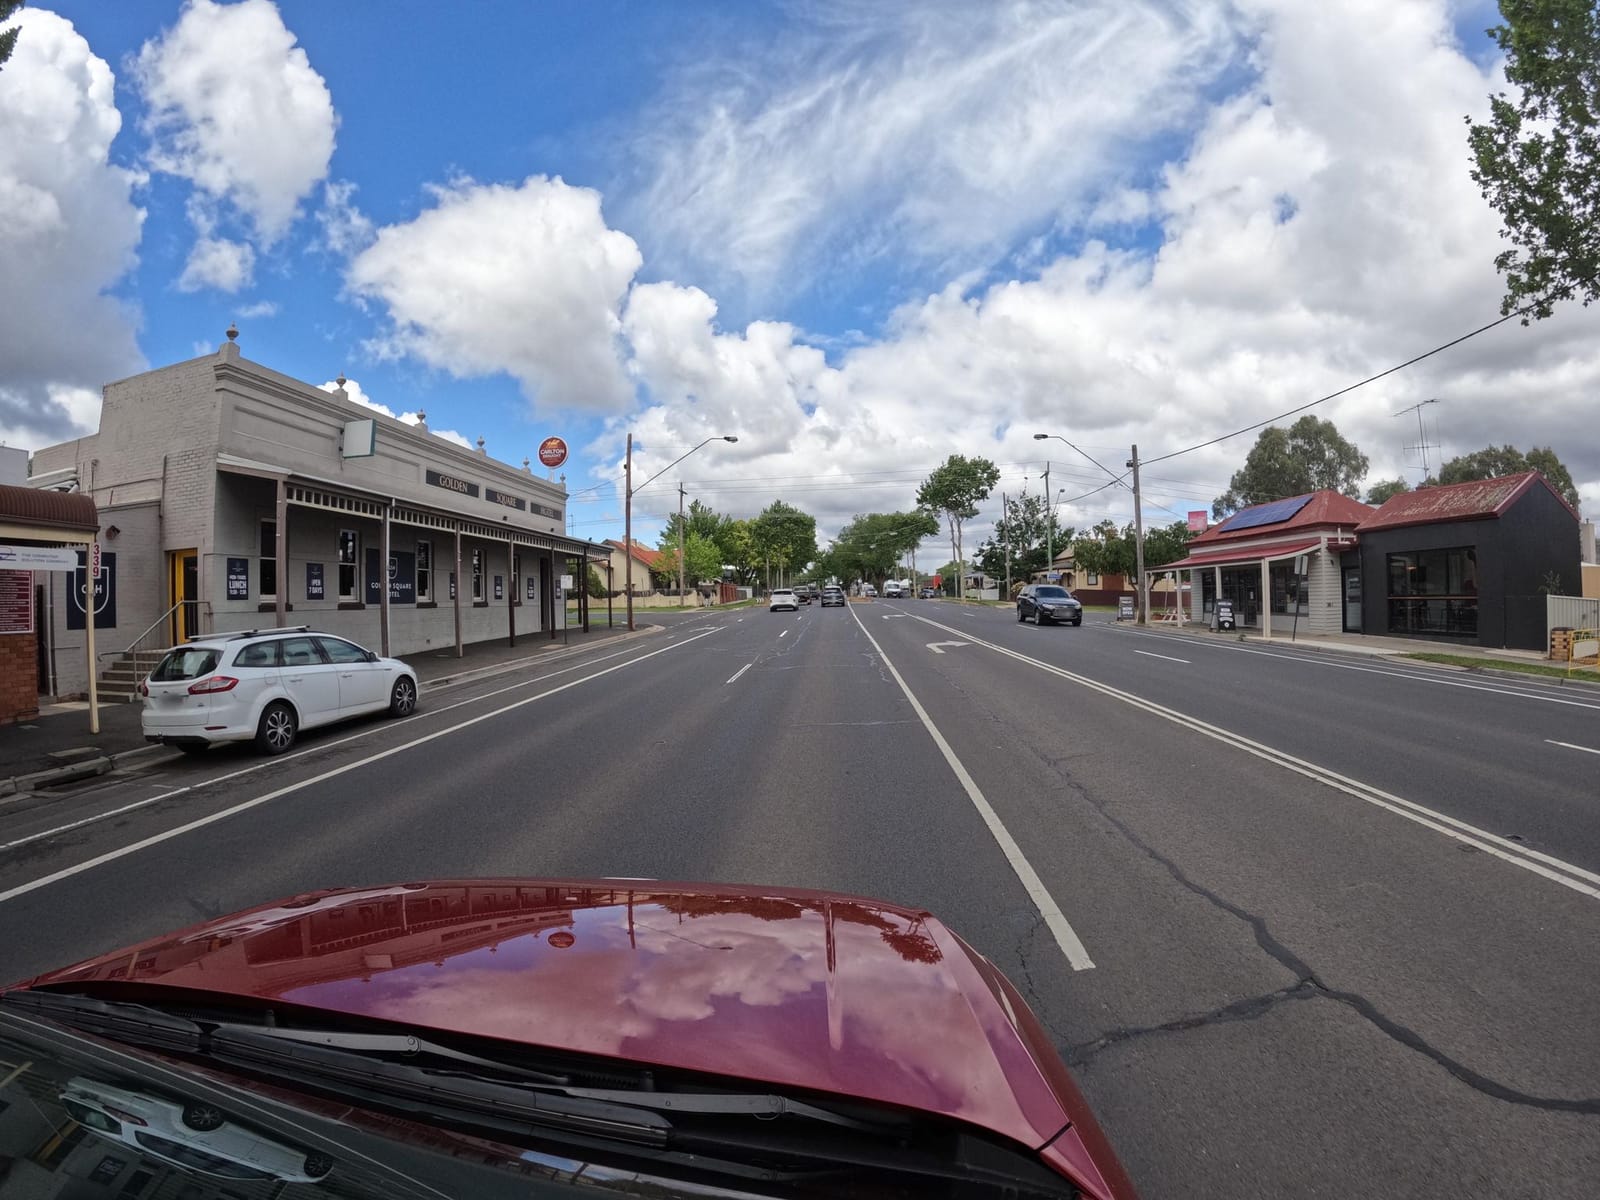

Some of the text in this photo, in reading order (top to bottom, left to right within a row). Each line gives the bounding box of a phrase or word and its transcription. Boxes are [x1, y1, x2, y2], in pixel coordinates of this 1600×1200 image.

[439, 475, 468, 493] GOLDEN
[496, 492, 517, 507] SQUARE
[92, 544, 100, 577] 339
[229, 580, 247, 589] LUNCH
[392, 582, 412, 590] SQUARE
